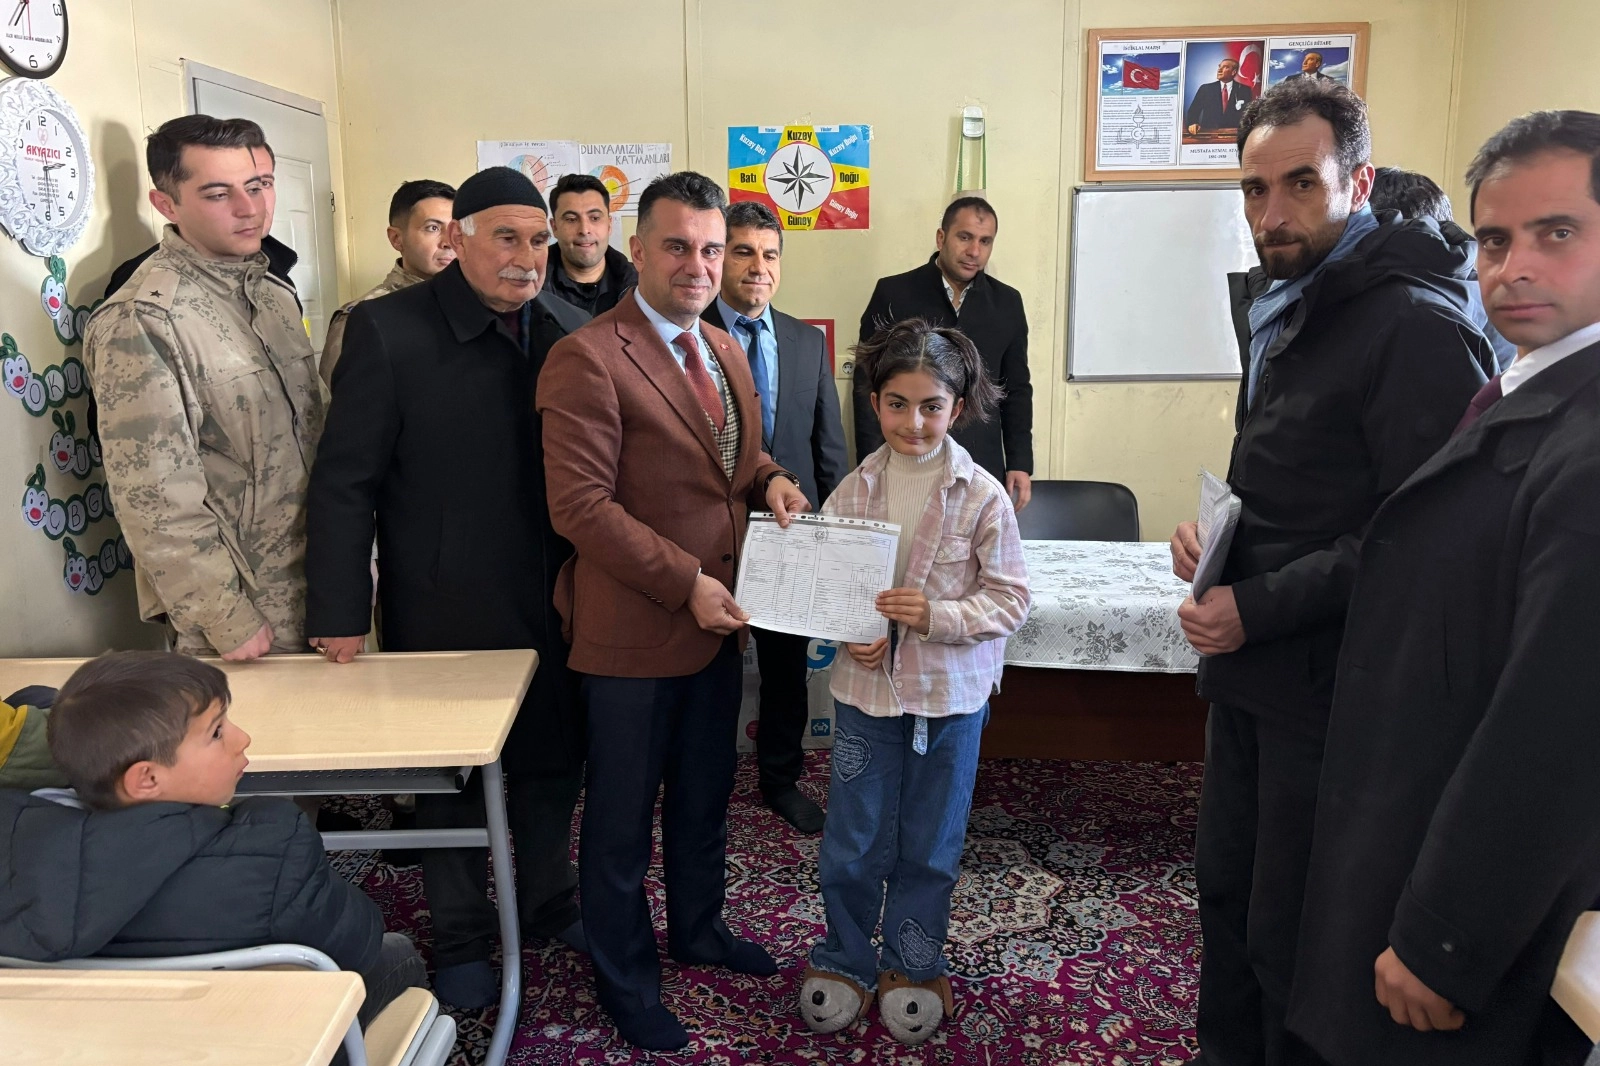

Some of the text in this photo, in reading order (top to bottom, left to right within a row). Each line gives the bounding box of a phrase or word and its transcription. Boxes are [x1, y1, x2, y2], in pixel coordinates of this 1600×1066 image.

[53, 3, 62, 16] 3
[28, 54, 39, 68] 6
[46, 52, 53, 61] 5
[37, 115, 47, 127] 12
[739, 133, 757, 150] Kuzey
[787, 130, 813, 142] Kuzey
[26, 144, 61, 160] AKYAZICI
[65, 146, 72, 158] 2
[615, 153, 670, 166] KATMANLARI
[70, 167, 76, 178] 3
[740, 173, 757, 183] Batı
[840, 172, 860, 184] Doğu
[67, 190, 74, 201] 4
[58, 206, 65, 217] 5
